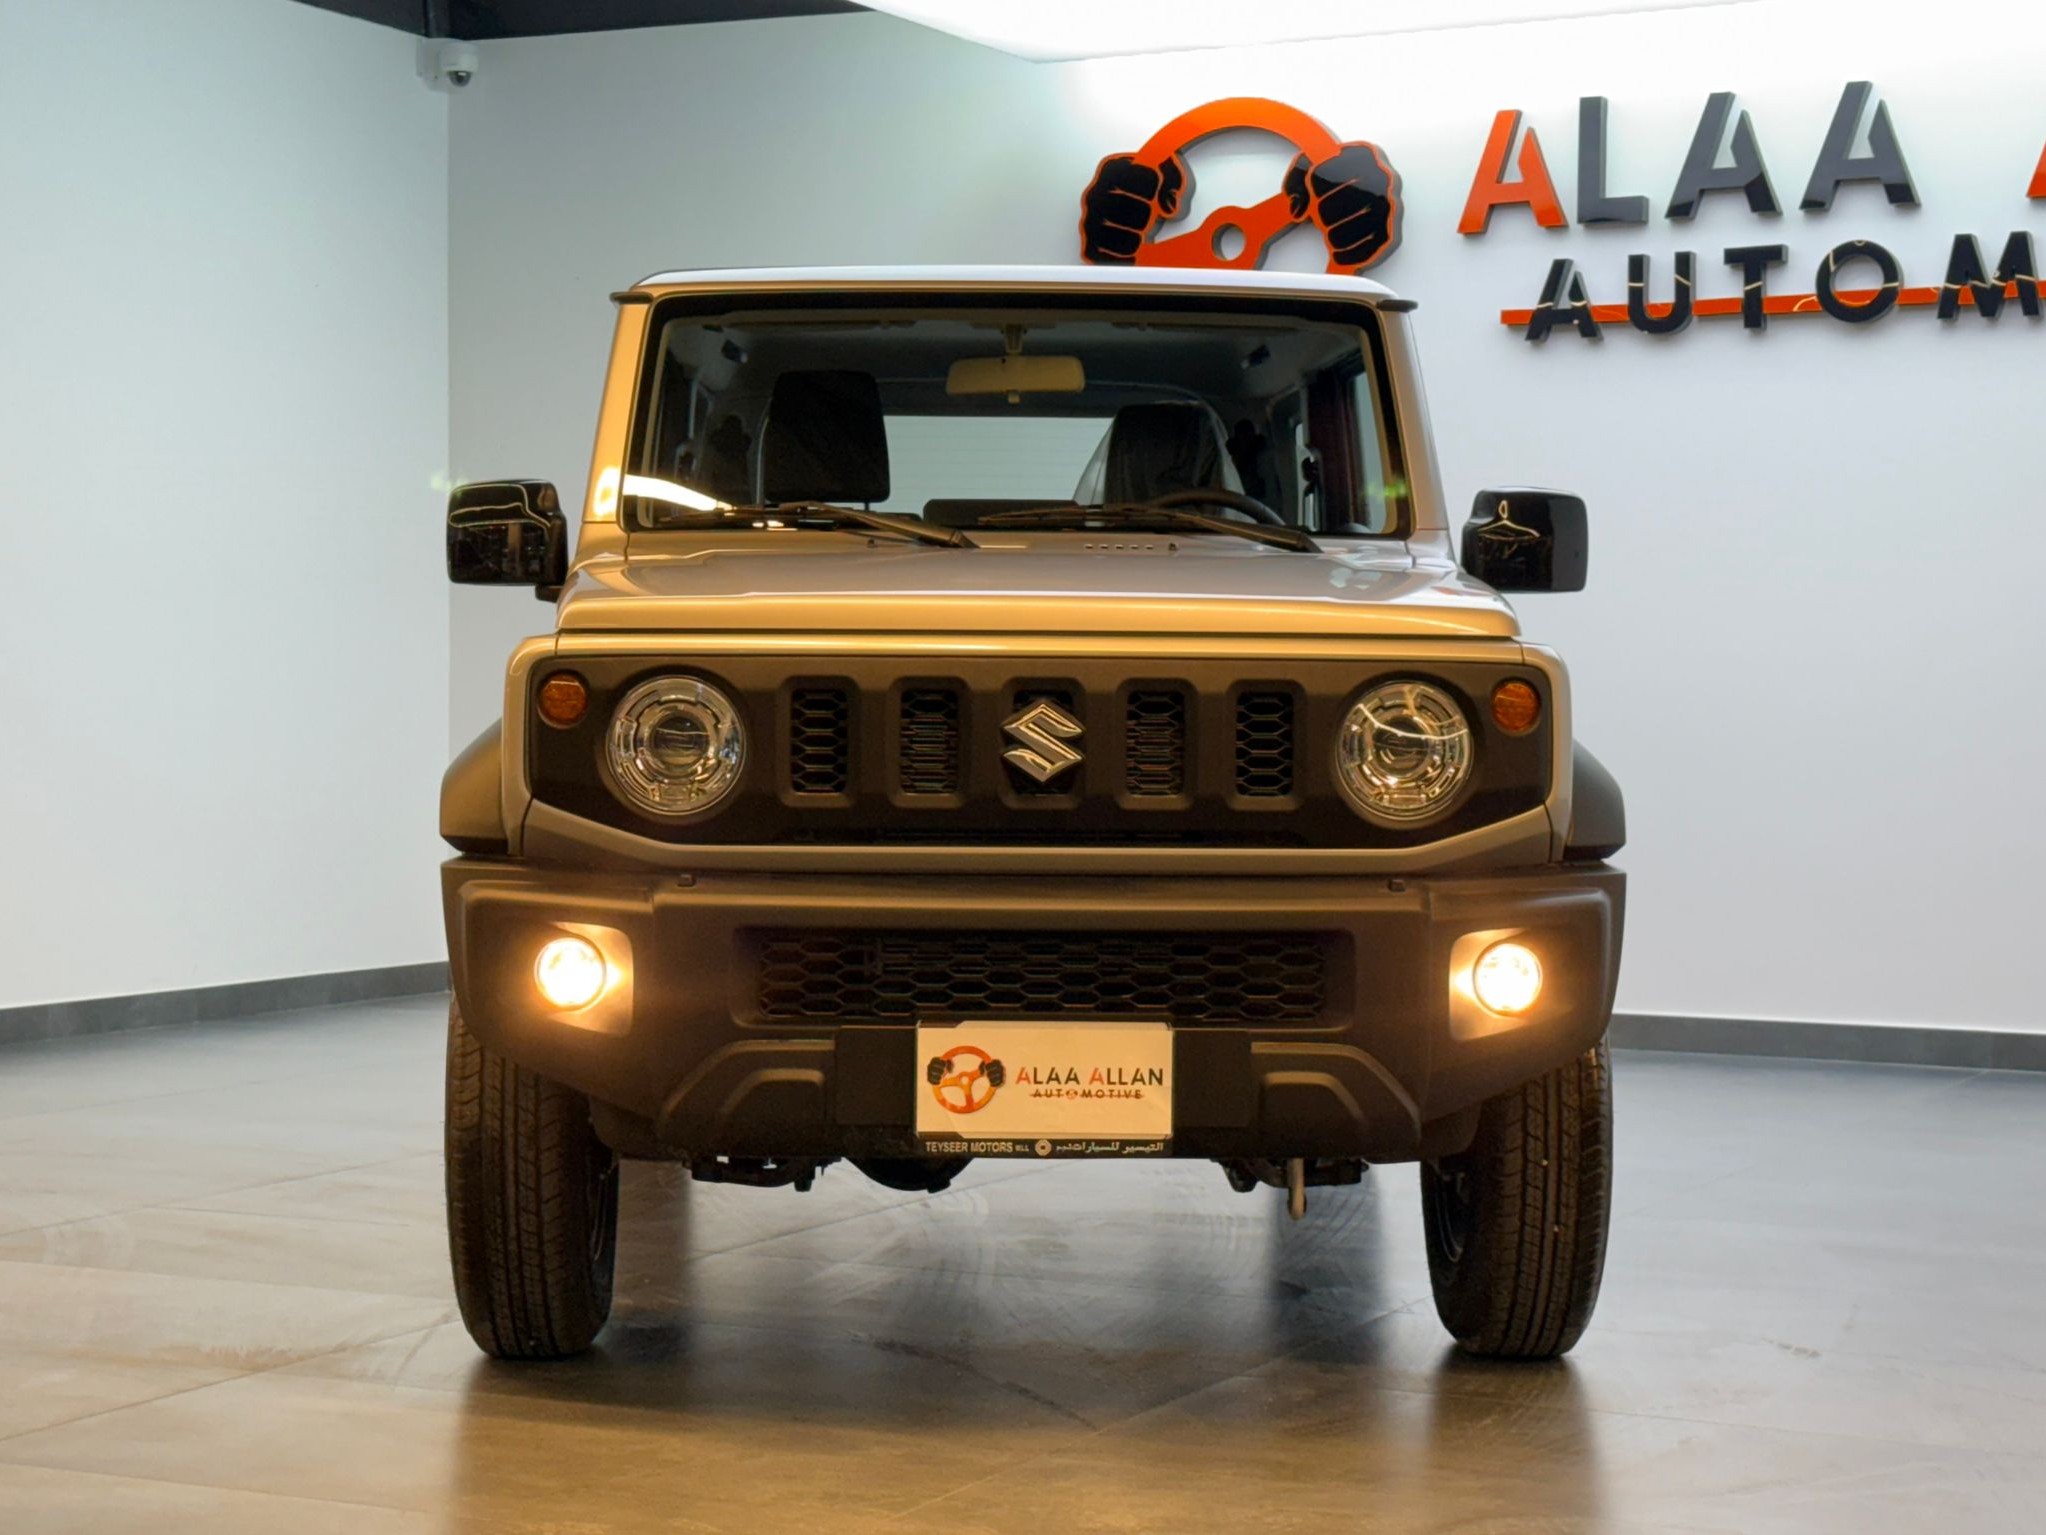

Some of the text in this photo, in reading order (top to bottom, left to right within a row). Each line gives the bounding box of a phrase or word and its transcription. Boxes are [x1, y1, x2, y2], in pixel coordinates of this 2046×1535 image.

[1457, 80, 1921, 235] ALAA
[1015, 1067, 1163, 1086] ALAA ALLAN
[925, 1141, 968, 1153] TEYSEER
[970, 1141, 1013, 1153] MOTORS
